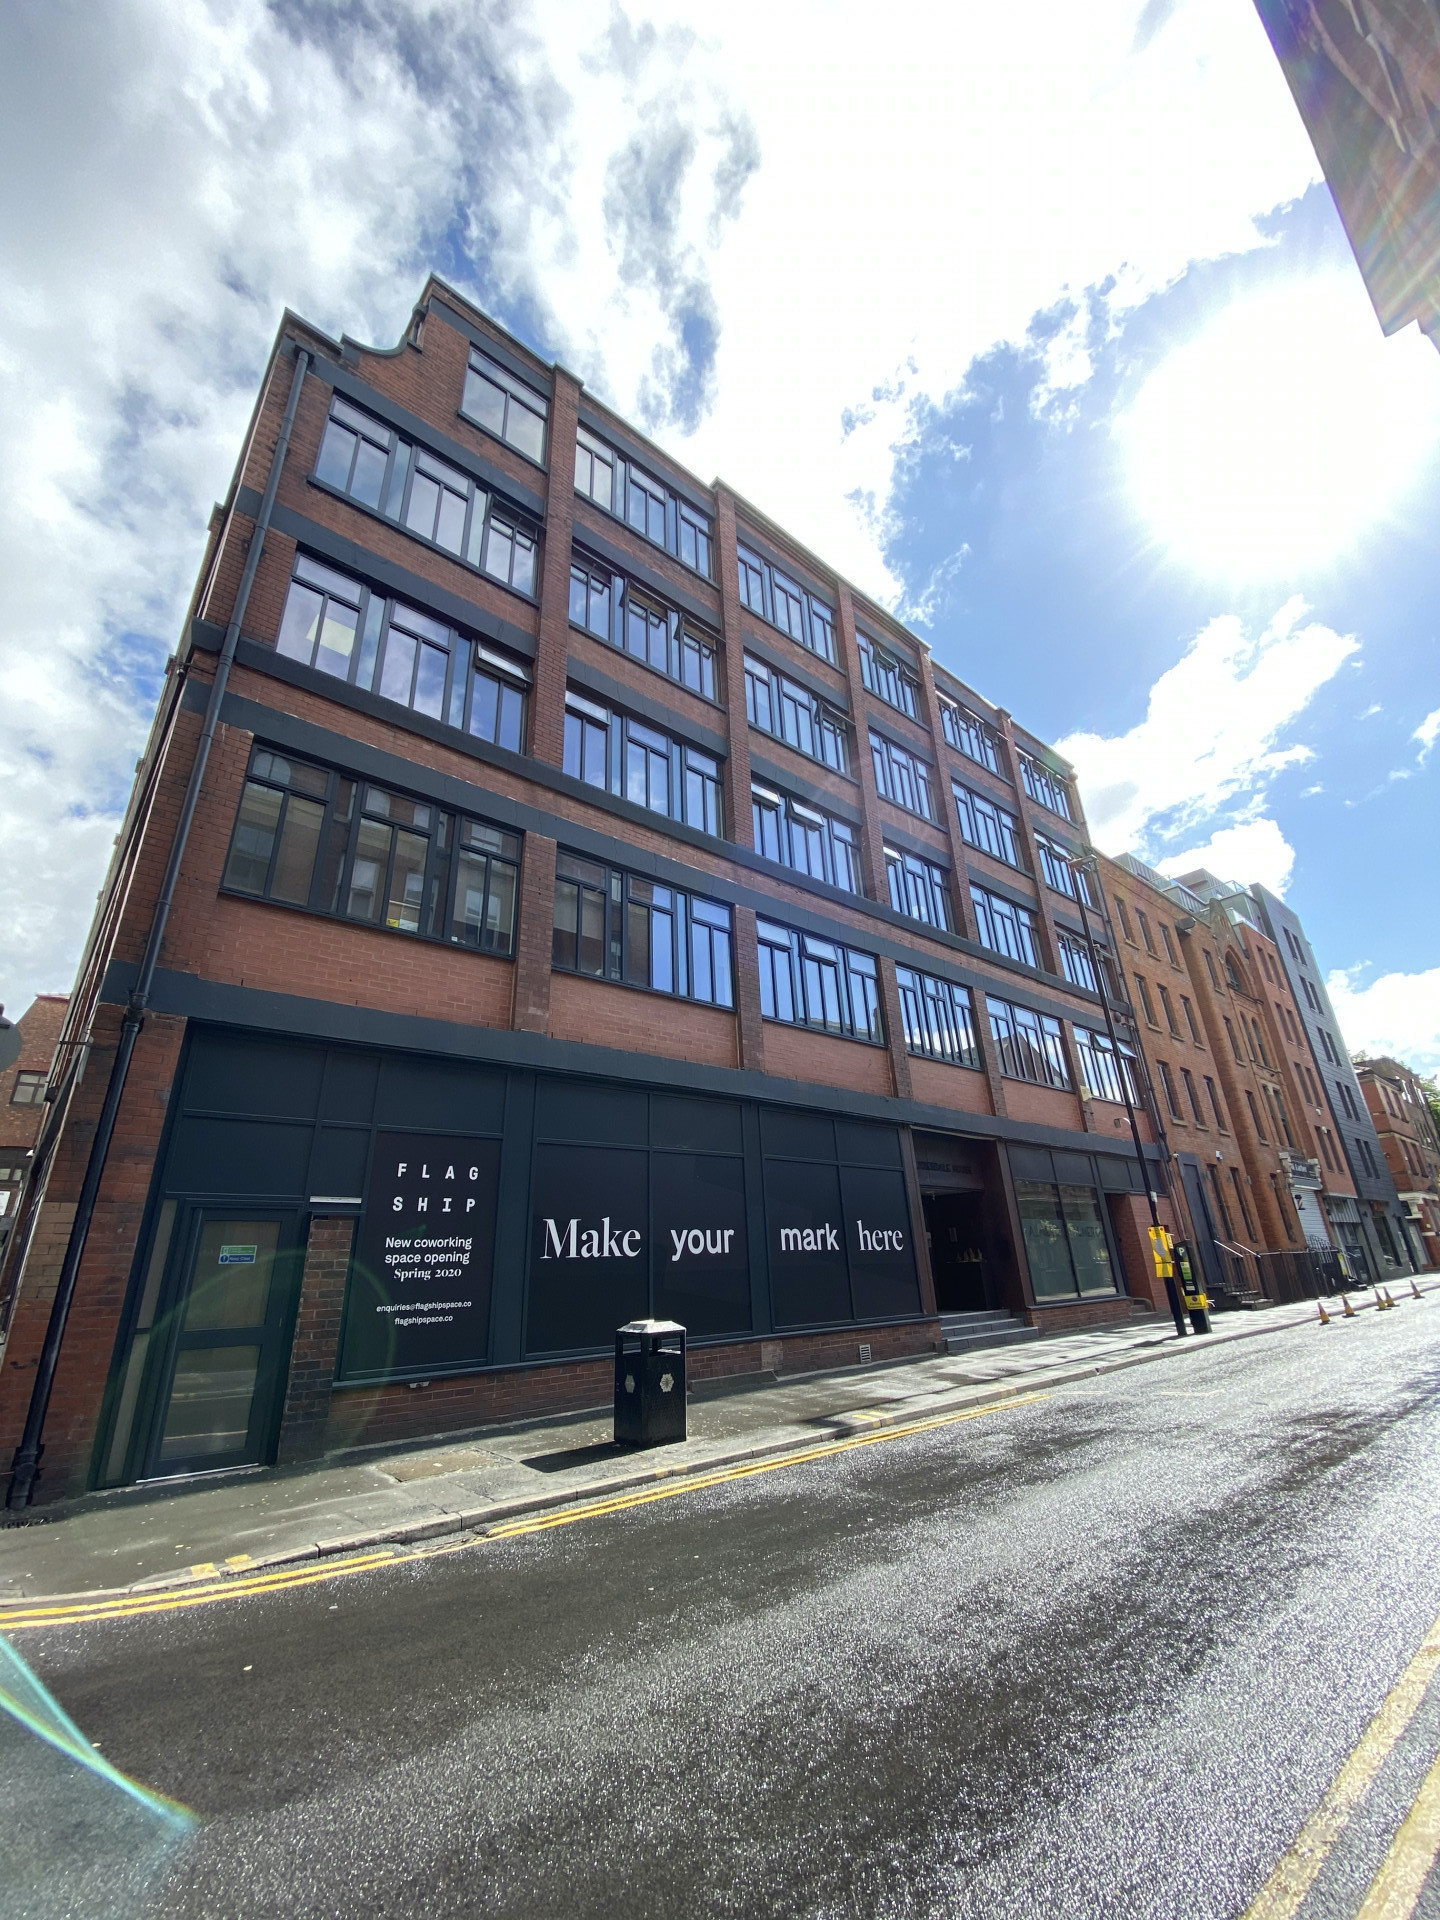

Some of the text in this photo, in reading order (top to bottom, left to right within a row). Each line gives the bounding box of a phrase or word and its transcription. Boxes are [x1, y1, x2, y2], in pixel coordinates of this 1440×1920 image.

[397, 1162, 479, 1180] FLAG
[392, 1196, 476, 1212] SHIP
[385, 1236, 473, 1250] New coworking
[540, 1216, 904, 1262] Make your mark here
[384, 1251, 470, 1267] space opening
[393, 1267, 462, 1282] Spring 2020
[376, 1301, 472, 1313] enquiries@flagshipspace.co
[394, 1315, 454, 1326] flagshipspace.co
